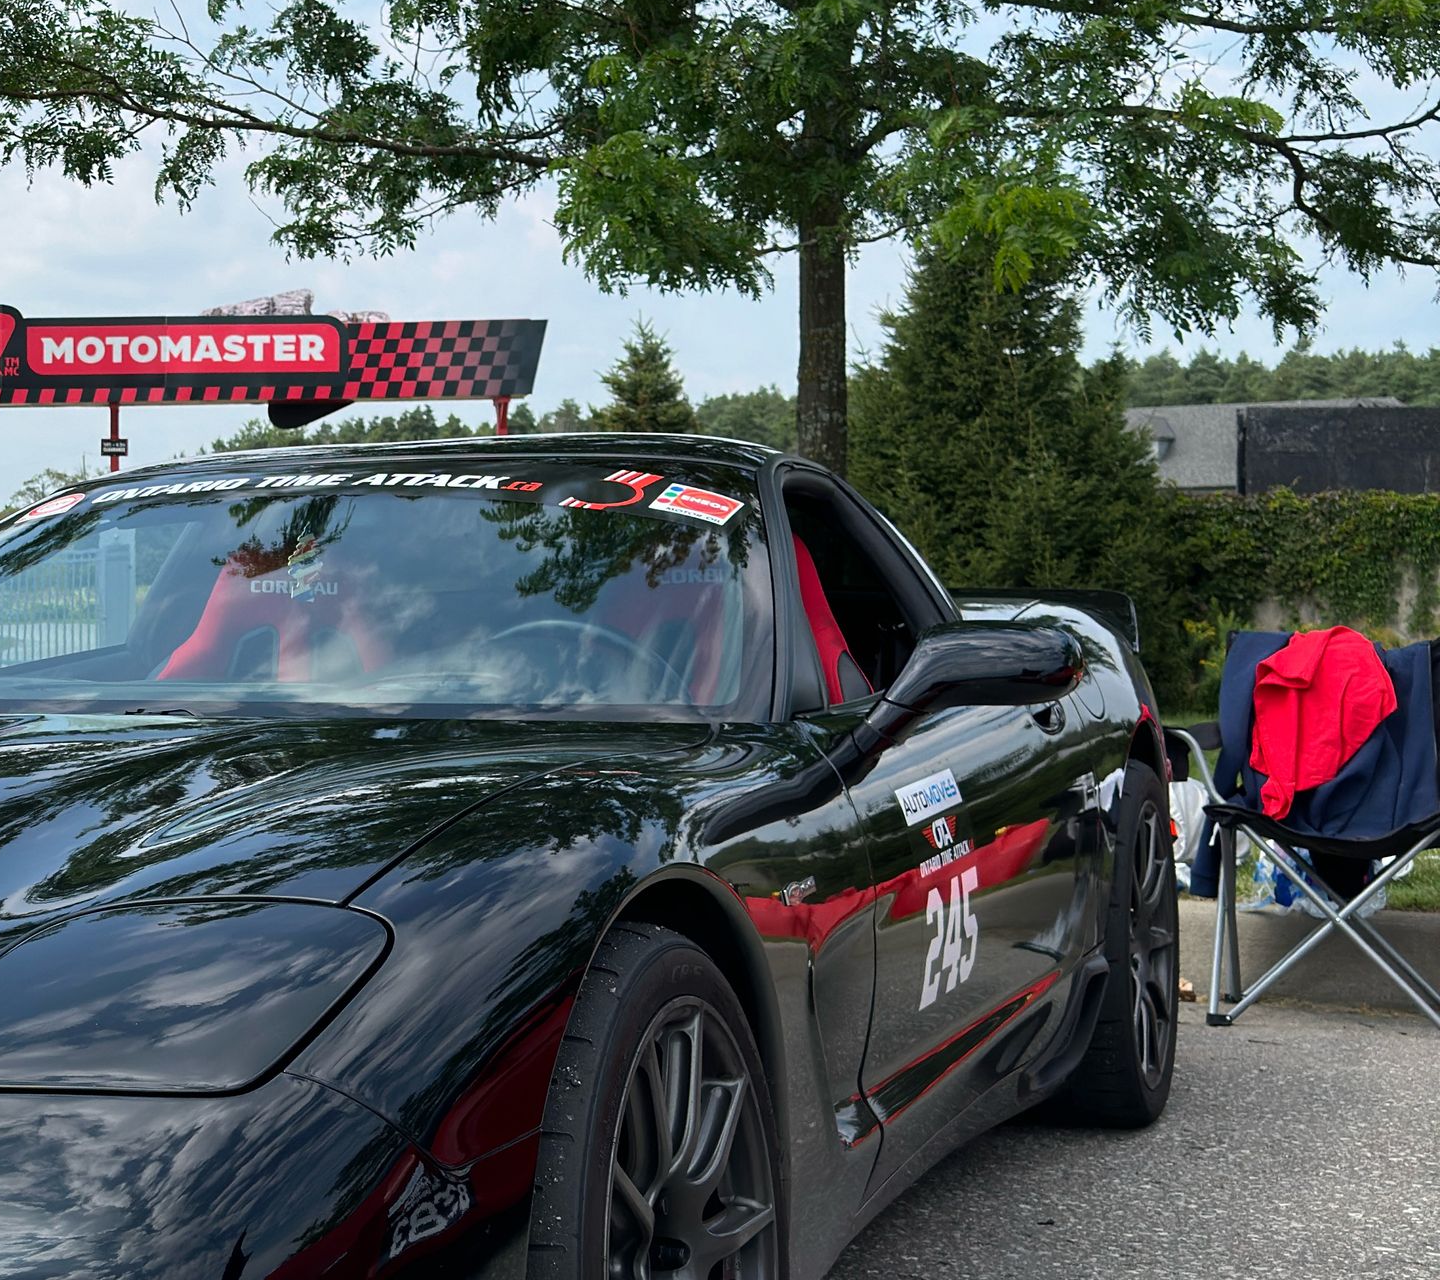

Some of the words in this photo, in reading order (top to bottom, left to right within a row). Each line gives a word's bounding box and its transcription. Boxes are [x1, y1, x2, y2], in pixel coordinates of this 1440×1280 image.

[5, 357, 19, 367] TM
[40, 333, 326, 365] MOTOMASTER
[91, 477, 250, 505] ONTARIO
[255, 473, 353, 489] TIME
[680, 494, 730, 512] ENEOS
[250, 579, 338, 596] CORAU
[902, 779, 958, 817] AUTOMOVES
[920, 854, 942, 879] ONTARIO
[940, 848, 954, 867] TIME
[918, 866, 979, 1012] 245
